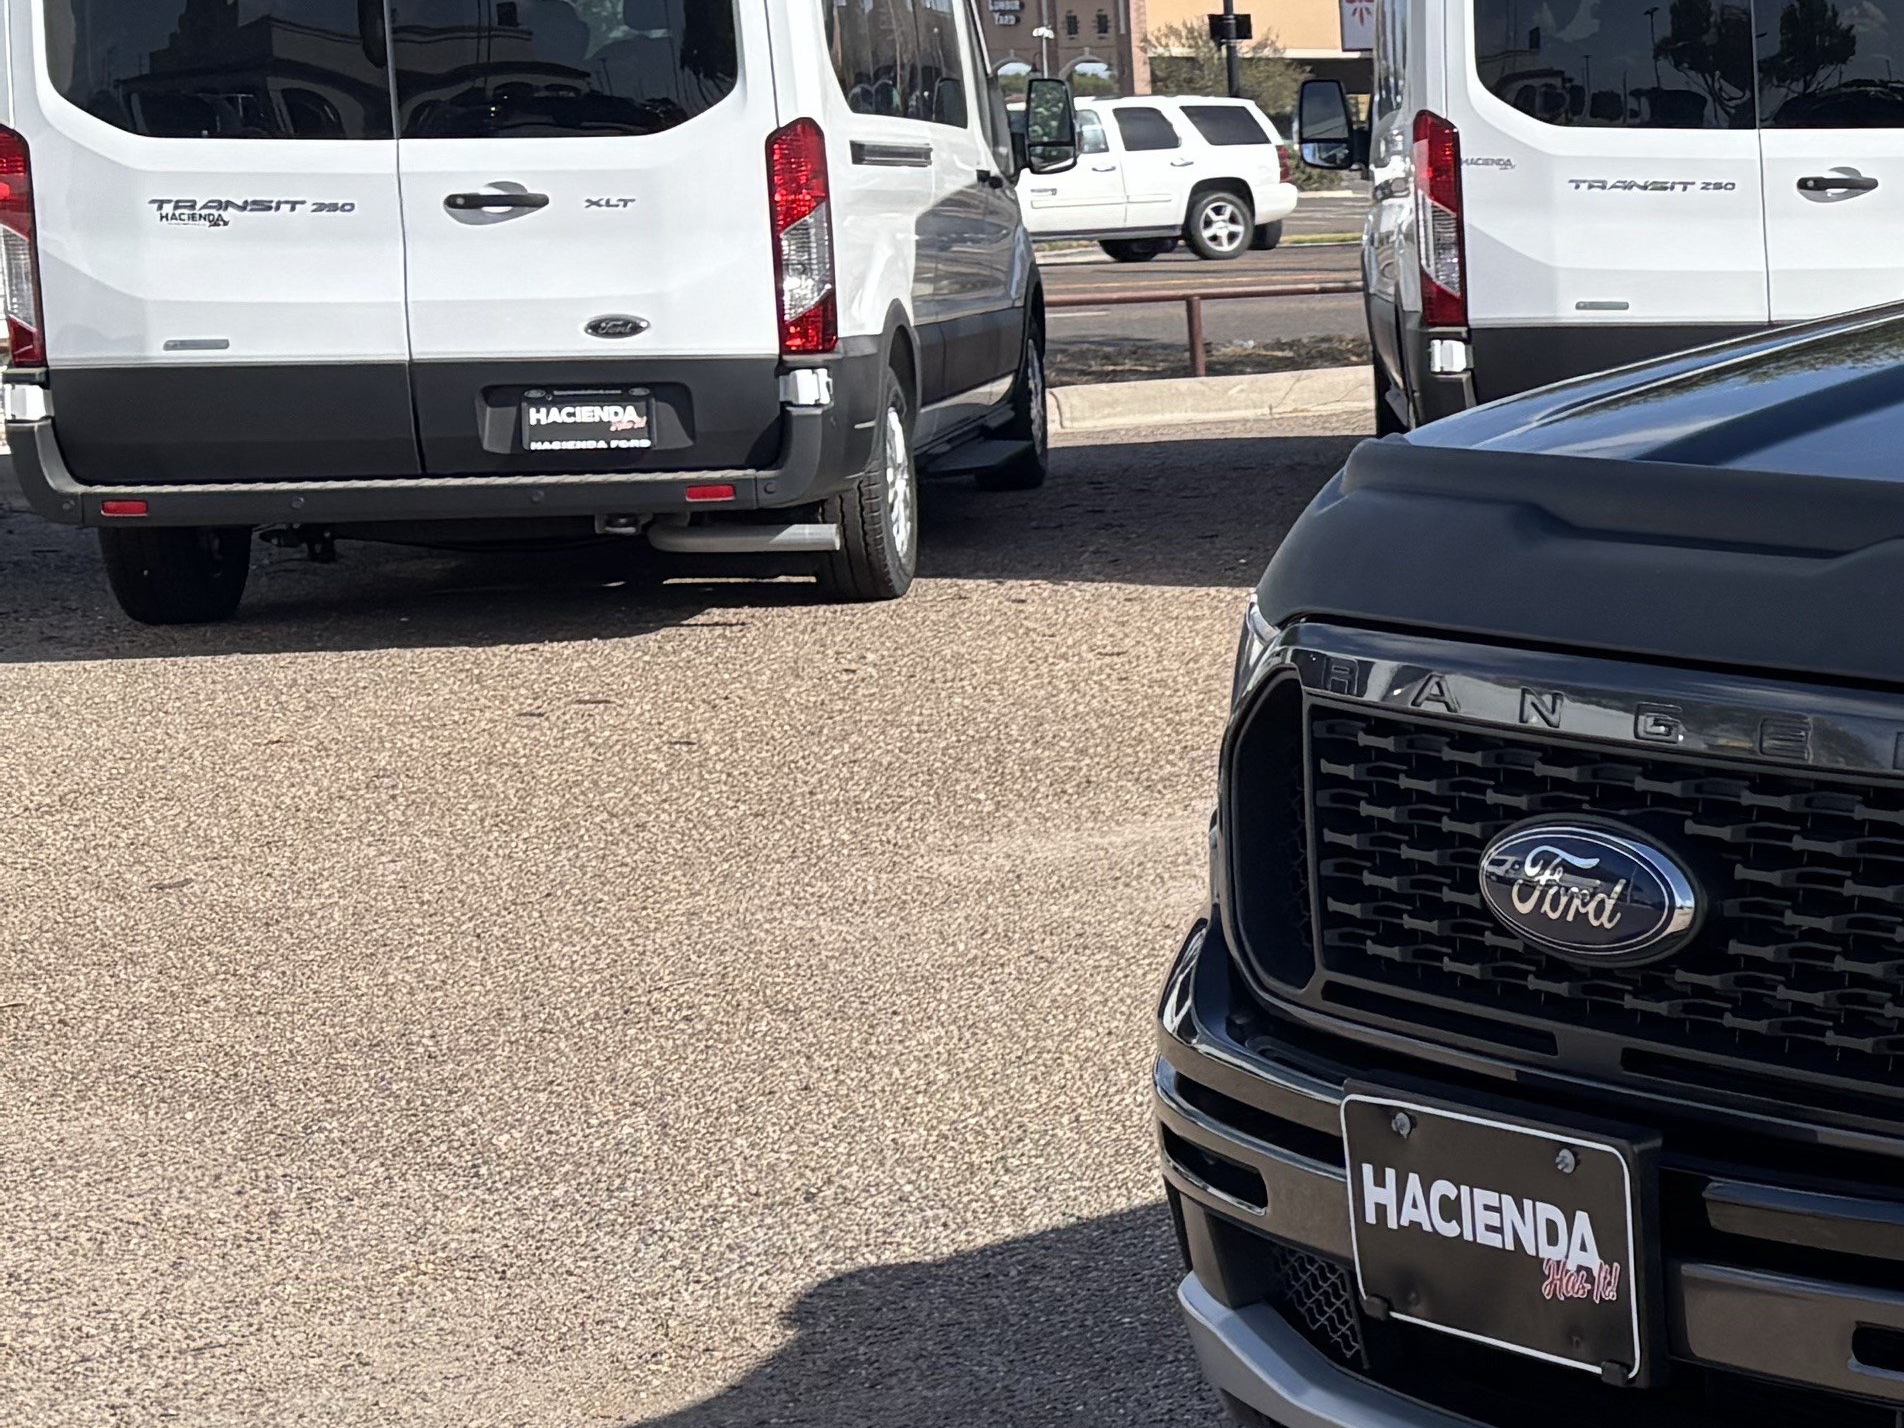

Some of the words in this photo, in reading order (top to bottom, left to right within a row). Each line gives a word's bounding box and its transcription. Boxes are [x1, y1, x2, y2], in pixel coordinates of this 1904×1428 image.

[1568, 179, 1696, 192] TRANSIT
[1700, 182, 1736, 191] 250
[149, 199, 306, 213] TRANSIT
[584, 198, 636, 208] XLT
[159, 213, 225, 223] HACIENDA
[529, 405, 639, 426] HACIENDA
[530, 439, 608, 451] HACIENDA
[610, 438, 651, 449] FORD
[1511, 845, 1627, 930] Ford
[1361, 1162, 1600, 1275] HACIENDA
[1541, 1256, 1591, 1302] Has
